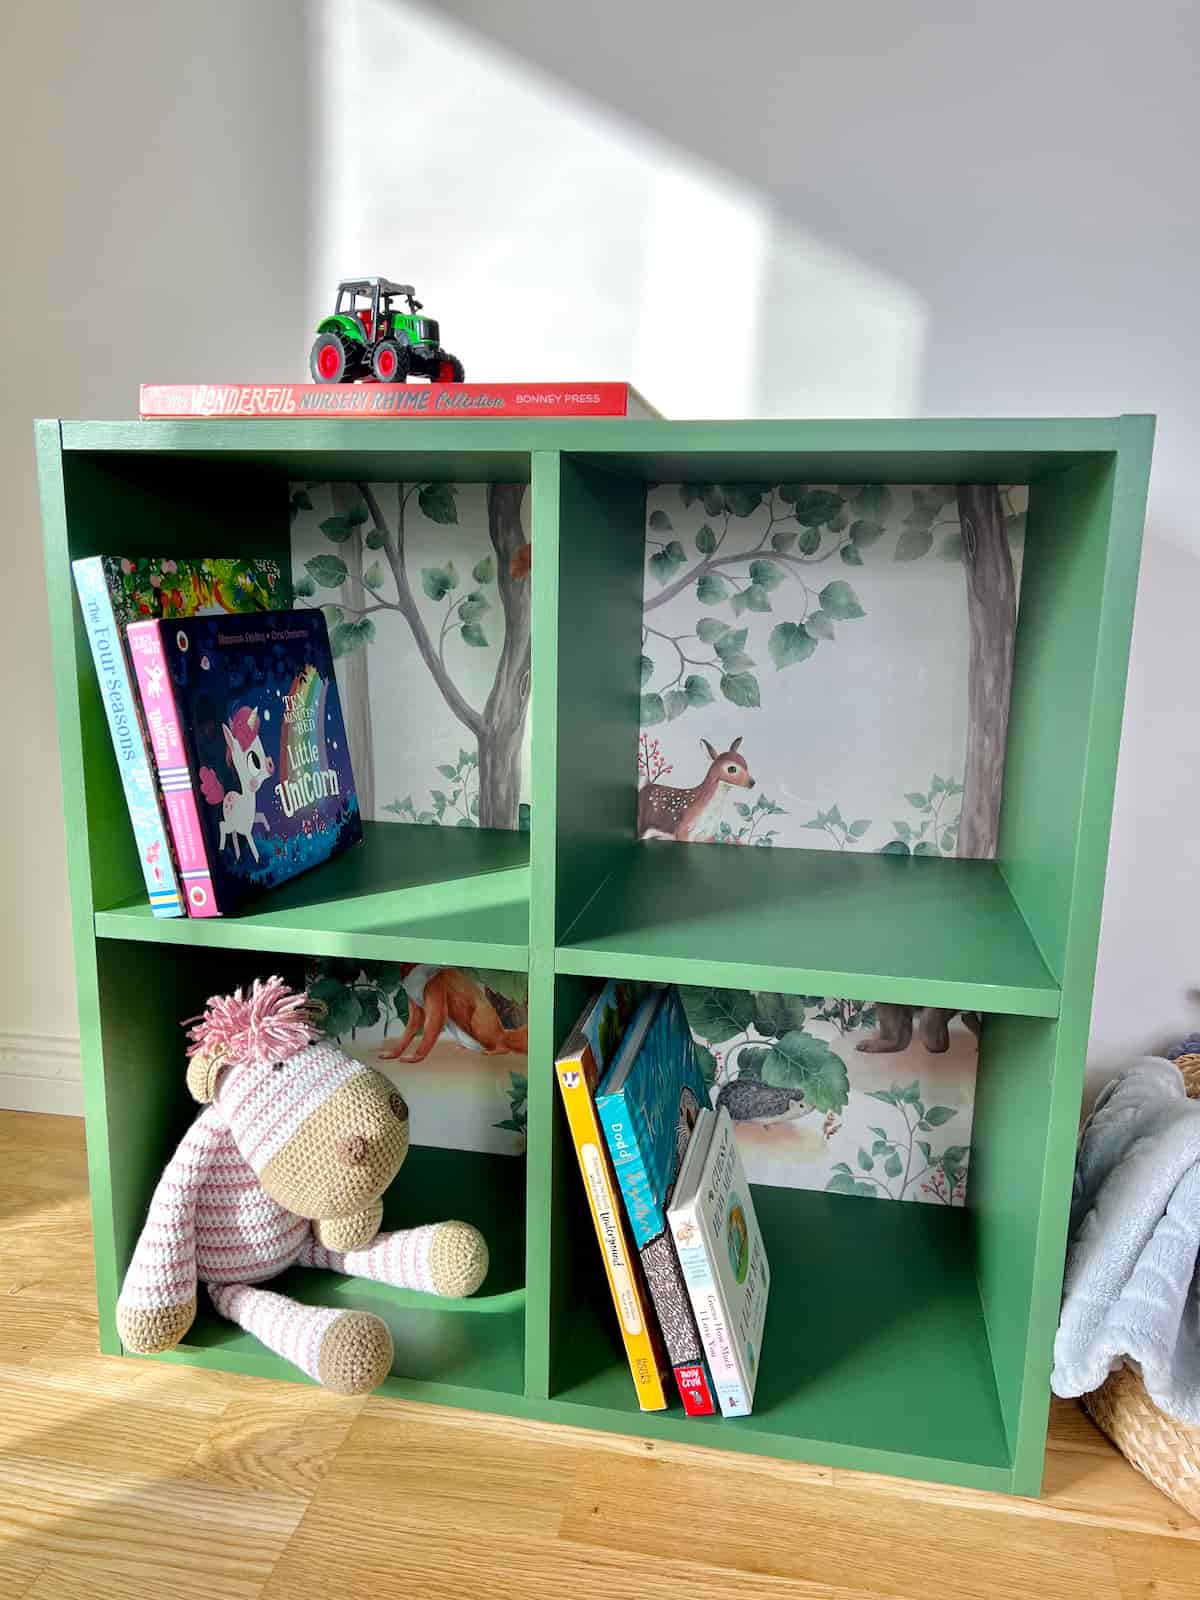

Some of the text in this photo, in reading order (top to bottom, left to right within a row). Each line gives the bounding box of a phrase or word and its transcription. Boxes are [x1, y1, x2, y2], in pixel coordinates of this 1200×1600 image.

[191, 385, 296, 415] WONDERFUL
[299, 391, 368, 410] NURSERY
[371, 390, 431, 411] RHYME
[434, 391, 507, 411] Collection
[515, 393, 561, 405] BONNEY
[564, 393, 600, 405] PRESS
[87, 601, 136, 762] The Four Seasons
[287, 742, 319, 770] Little
[611, 1123, 632, 1158] Dodd
[600, 1211, 624, 1267] Underground
